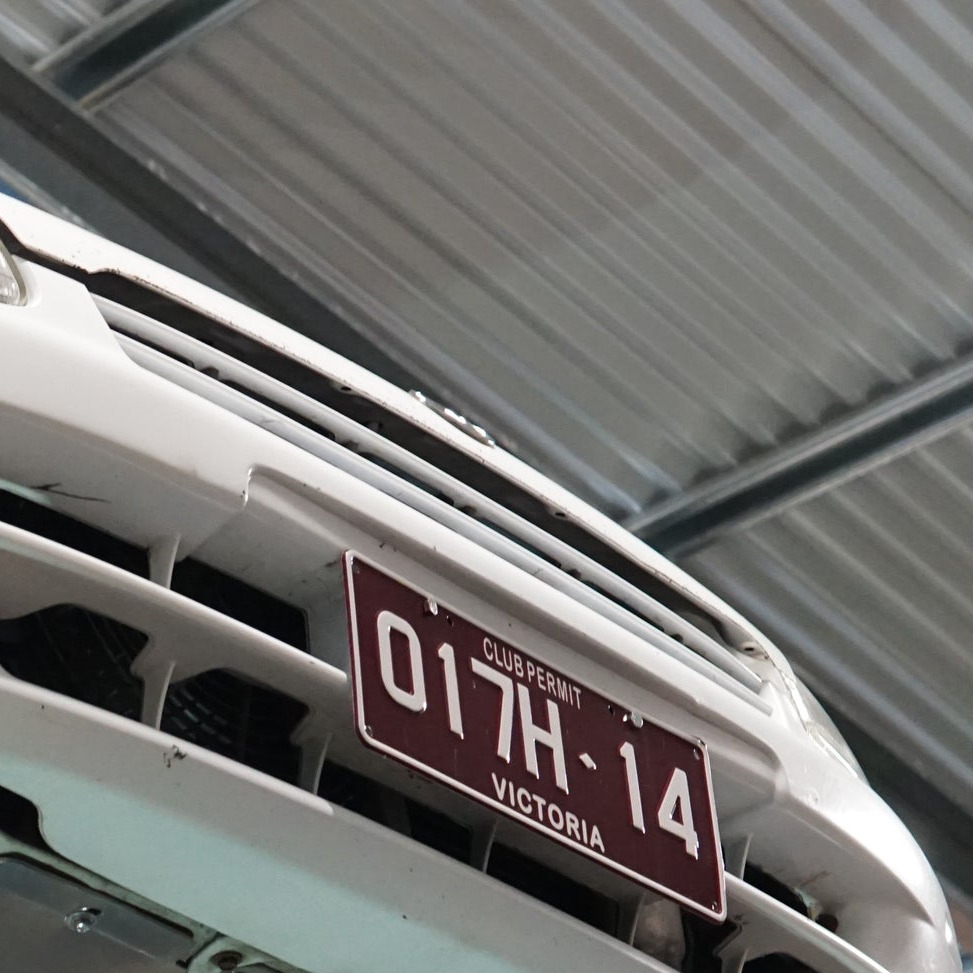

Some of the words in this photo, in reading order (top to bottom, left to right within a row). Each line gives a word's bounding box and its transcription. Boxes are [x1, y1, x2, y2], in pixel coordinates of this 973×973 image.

[483, 637, 525, 678] CLUB
[527, 661, 582, 710] PERMIT
[491, 773, 605, 853] VICTORIA
